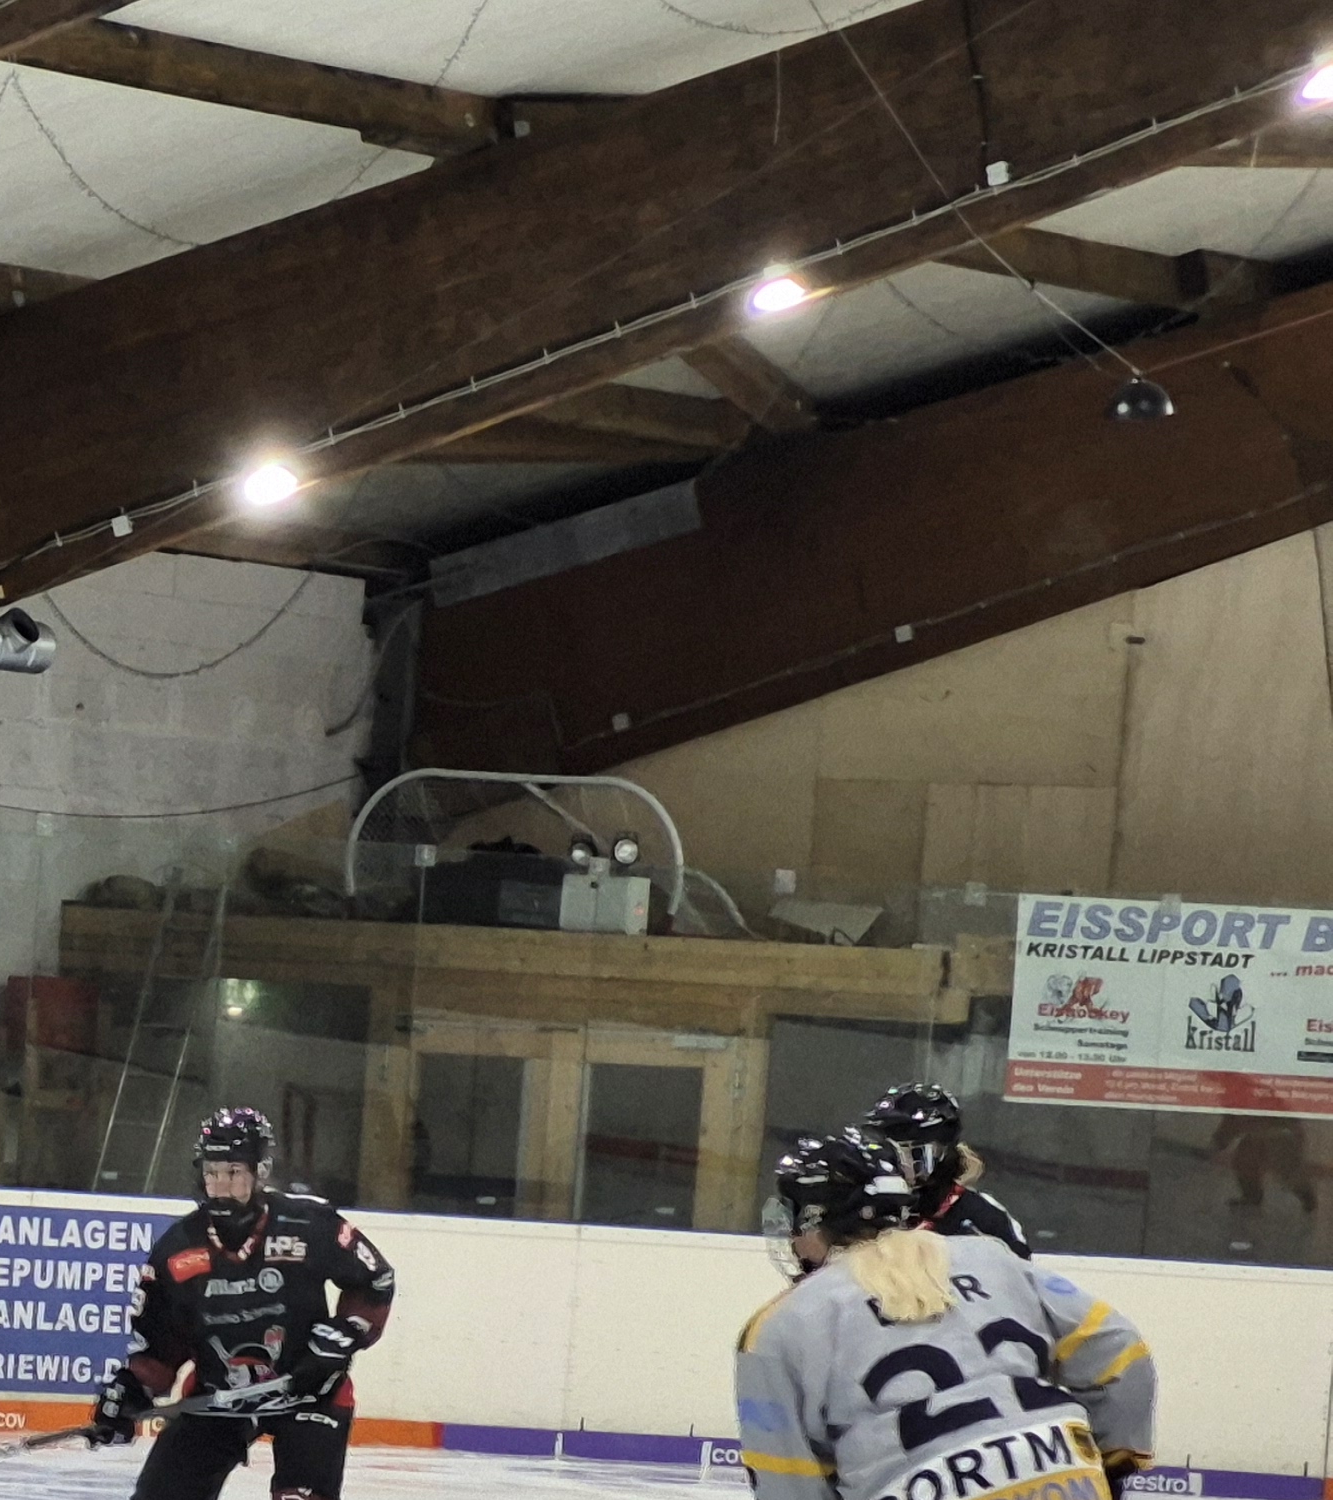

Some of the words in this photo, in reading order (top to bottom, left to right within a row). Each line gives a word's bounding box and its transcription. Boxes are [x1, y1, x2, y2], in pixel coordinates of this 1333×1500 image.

[1026, 900, 1291, 950] EISSPORT
[1026, 942, 1130, 963] KRISTALL
[1137, 948, 1255, 969] LIPPSTADT
